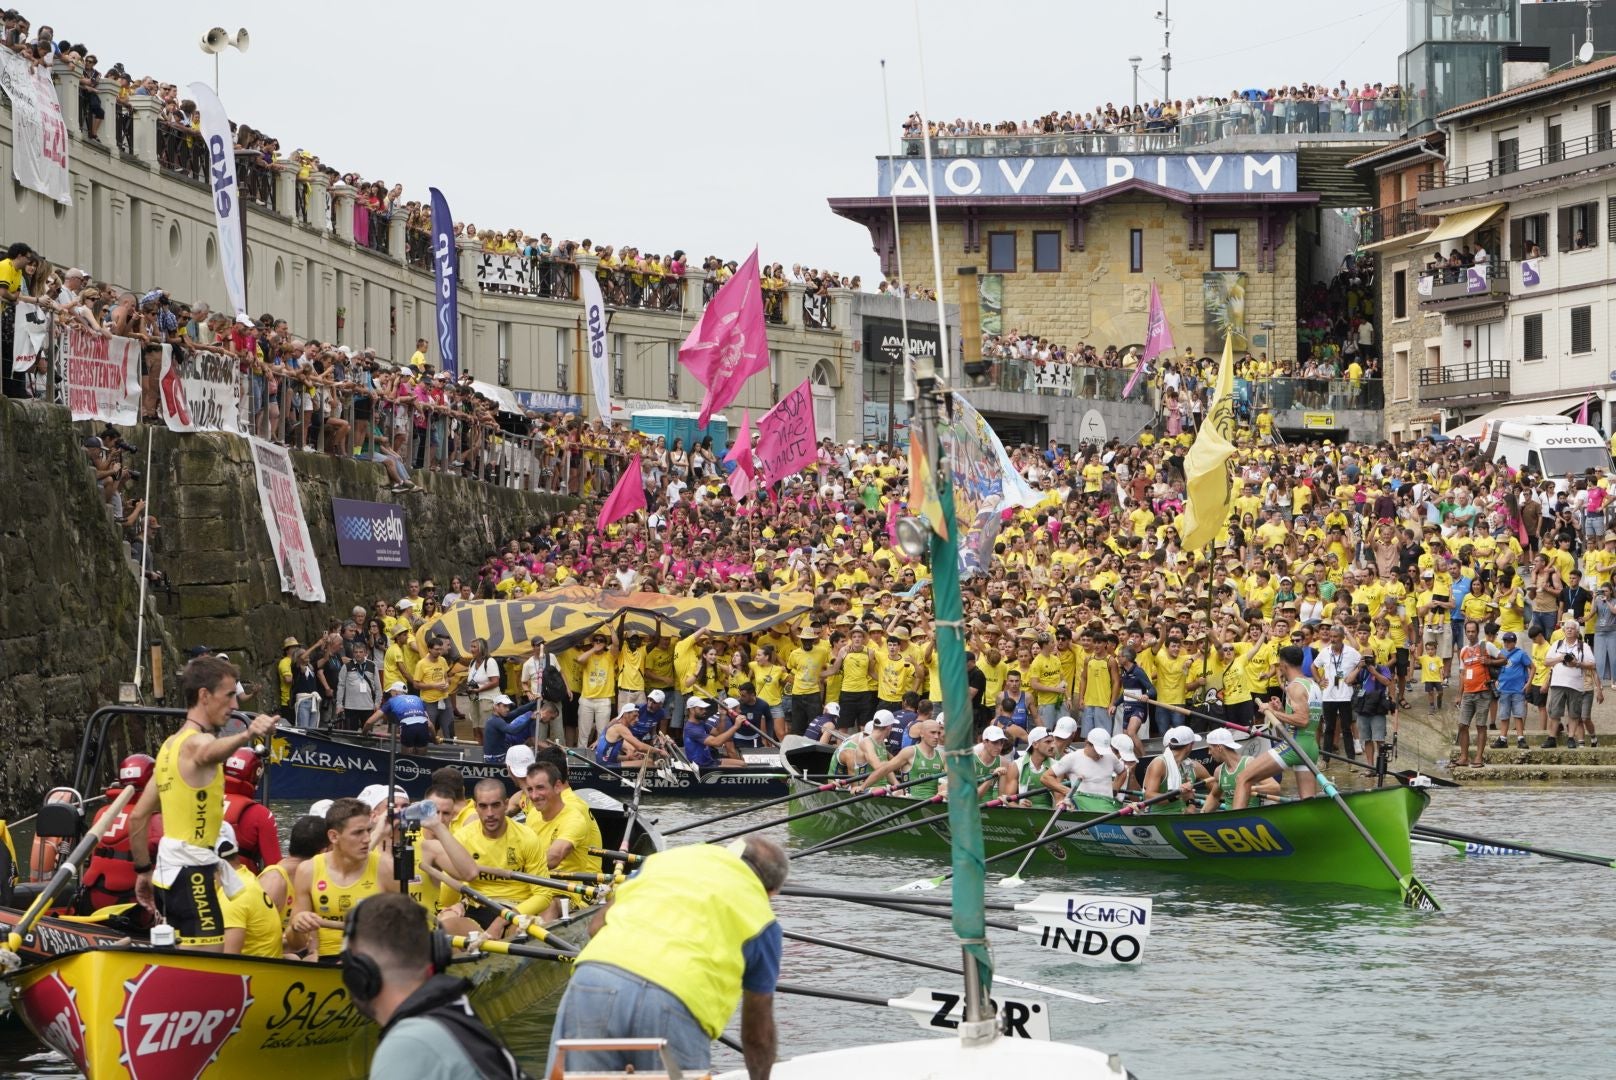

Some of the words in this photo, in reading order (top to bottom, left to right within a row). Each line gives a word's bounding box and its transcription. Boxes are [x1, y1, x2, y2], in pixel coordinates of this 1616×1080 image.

[1546, 436, 1597, 445] overon
[387, 509, 403, 547] ekp
[620, 778, 690, 788] RMEO
[720, 774, 769, 785] satlink
[1217, 824, 1283, 853] BM
[190, 872, 216, 932] ORIALKI
[1066, 898, 1147, 927] KEMEN
[1040, 926, 1141, 963] INDO
[266, 981, 378, 1031] SAGA
